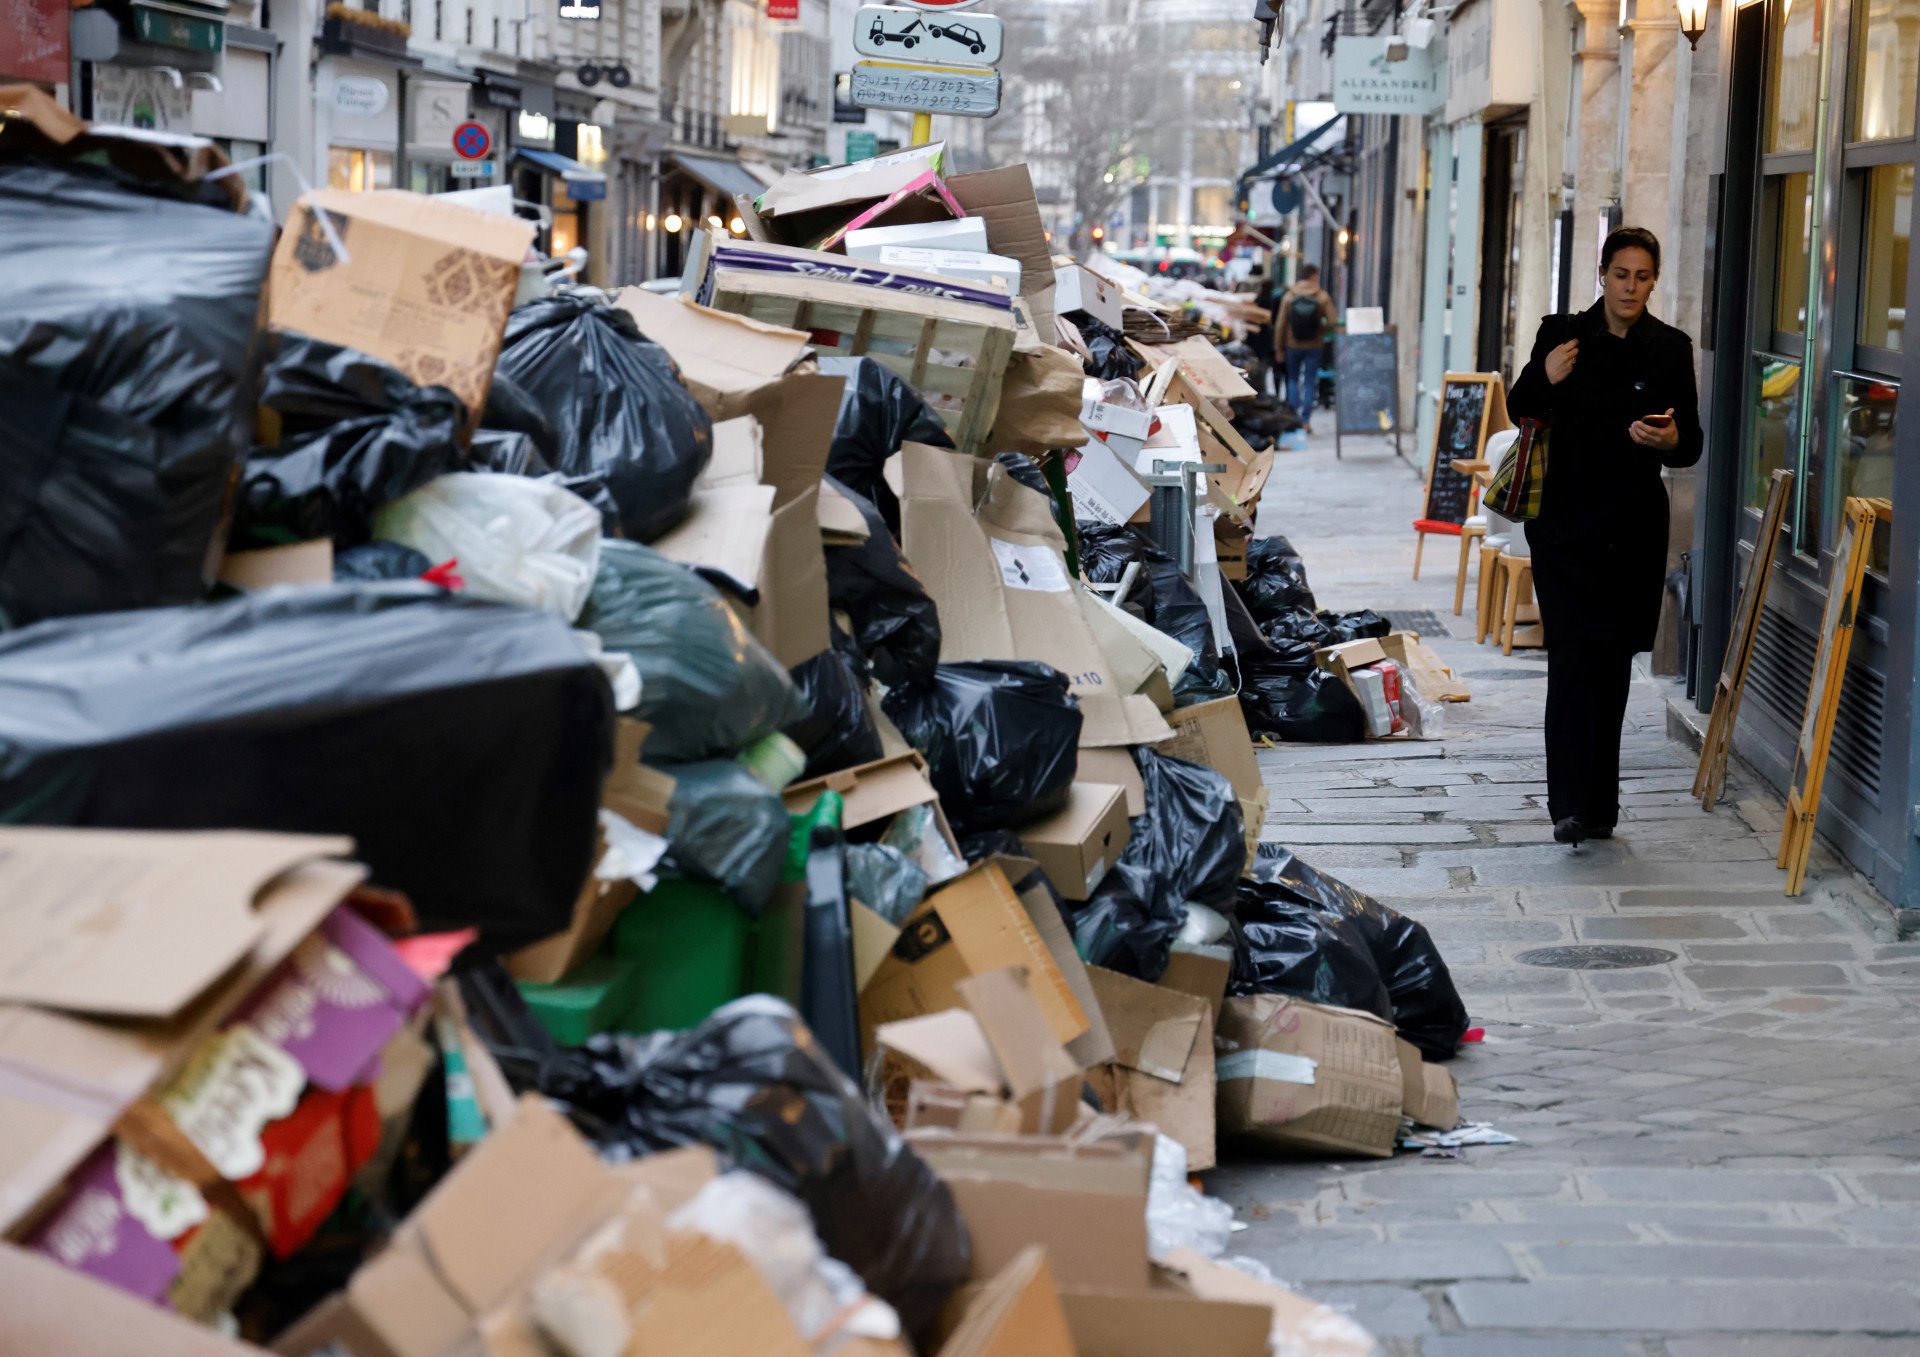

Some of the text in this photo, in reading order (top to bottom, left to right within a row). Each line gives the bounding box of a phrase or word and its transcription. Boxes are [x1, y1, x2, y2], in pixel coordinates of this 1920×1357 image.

[1341, 79, 1429, 89] ALEXANDRE
[1352, 93, 1417, 103] MAREUIL
[791, 261, 964, 300] Saint Louis
[1083, 671, 1102, 685] 10
